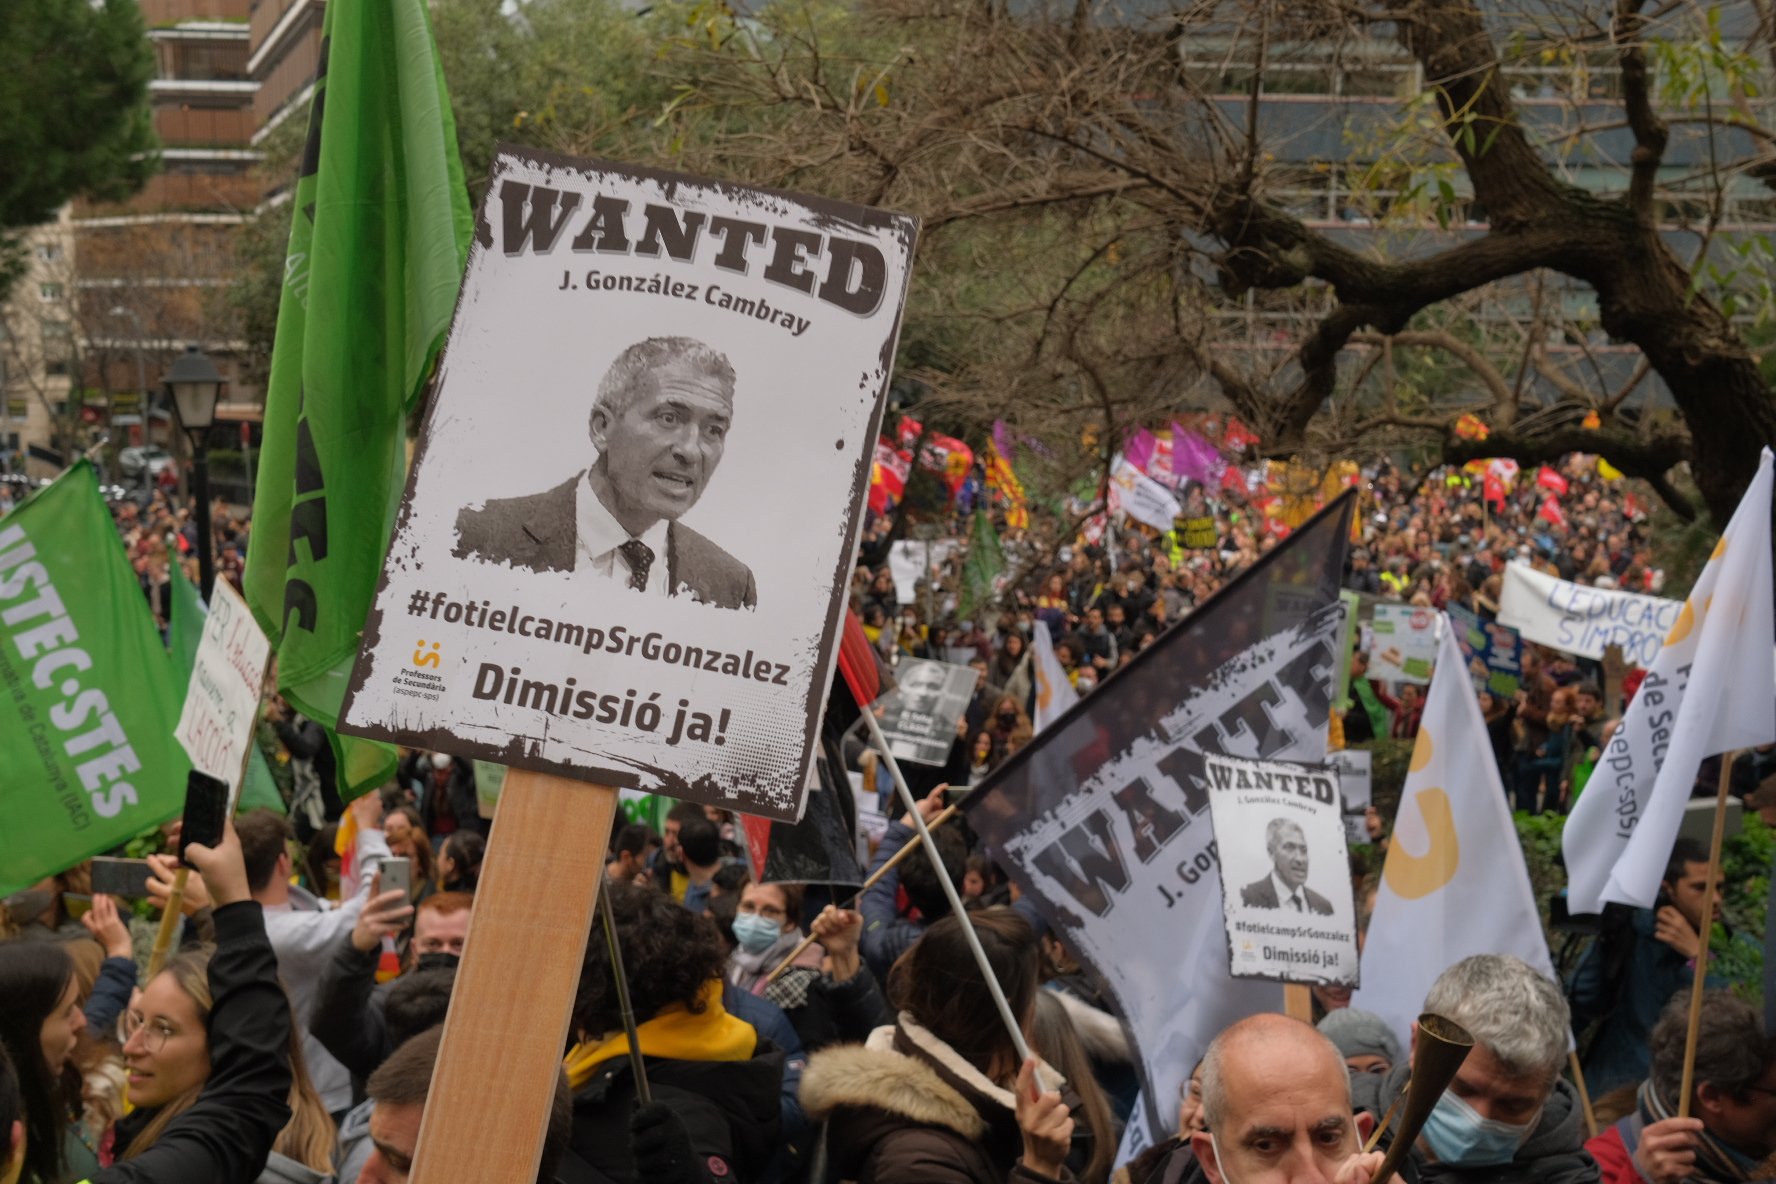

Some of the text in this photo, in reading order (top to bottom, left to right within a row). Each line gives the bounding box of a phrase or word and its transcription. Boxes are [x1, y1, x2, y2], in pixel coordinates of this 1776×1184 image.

[499, 179, 889, 319] WANTED
[558, 269, 812, 337] J. González Cambray
[407, 588, 793, 687] #fotielcampSrGonzalez
[392, 676, 403, 684] de
[400, 668, 442, 682] Professors
[1643, 671, 1669, 707] de
[471, 661, 733, 747] Dimissió ja!
[1209, 762, 1335, 806] WANTED
[1157, 883, 1184, 909] J.
[1262, 945, 1320, 966] Dimissió
[1321, 949, 1340, 969] ja!
